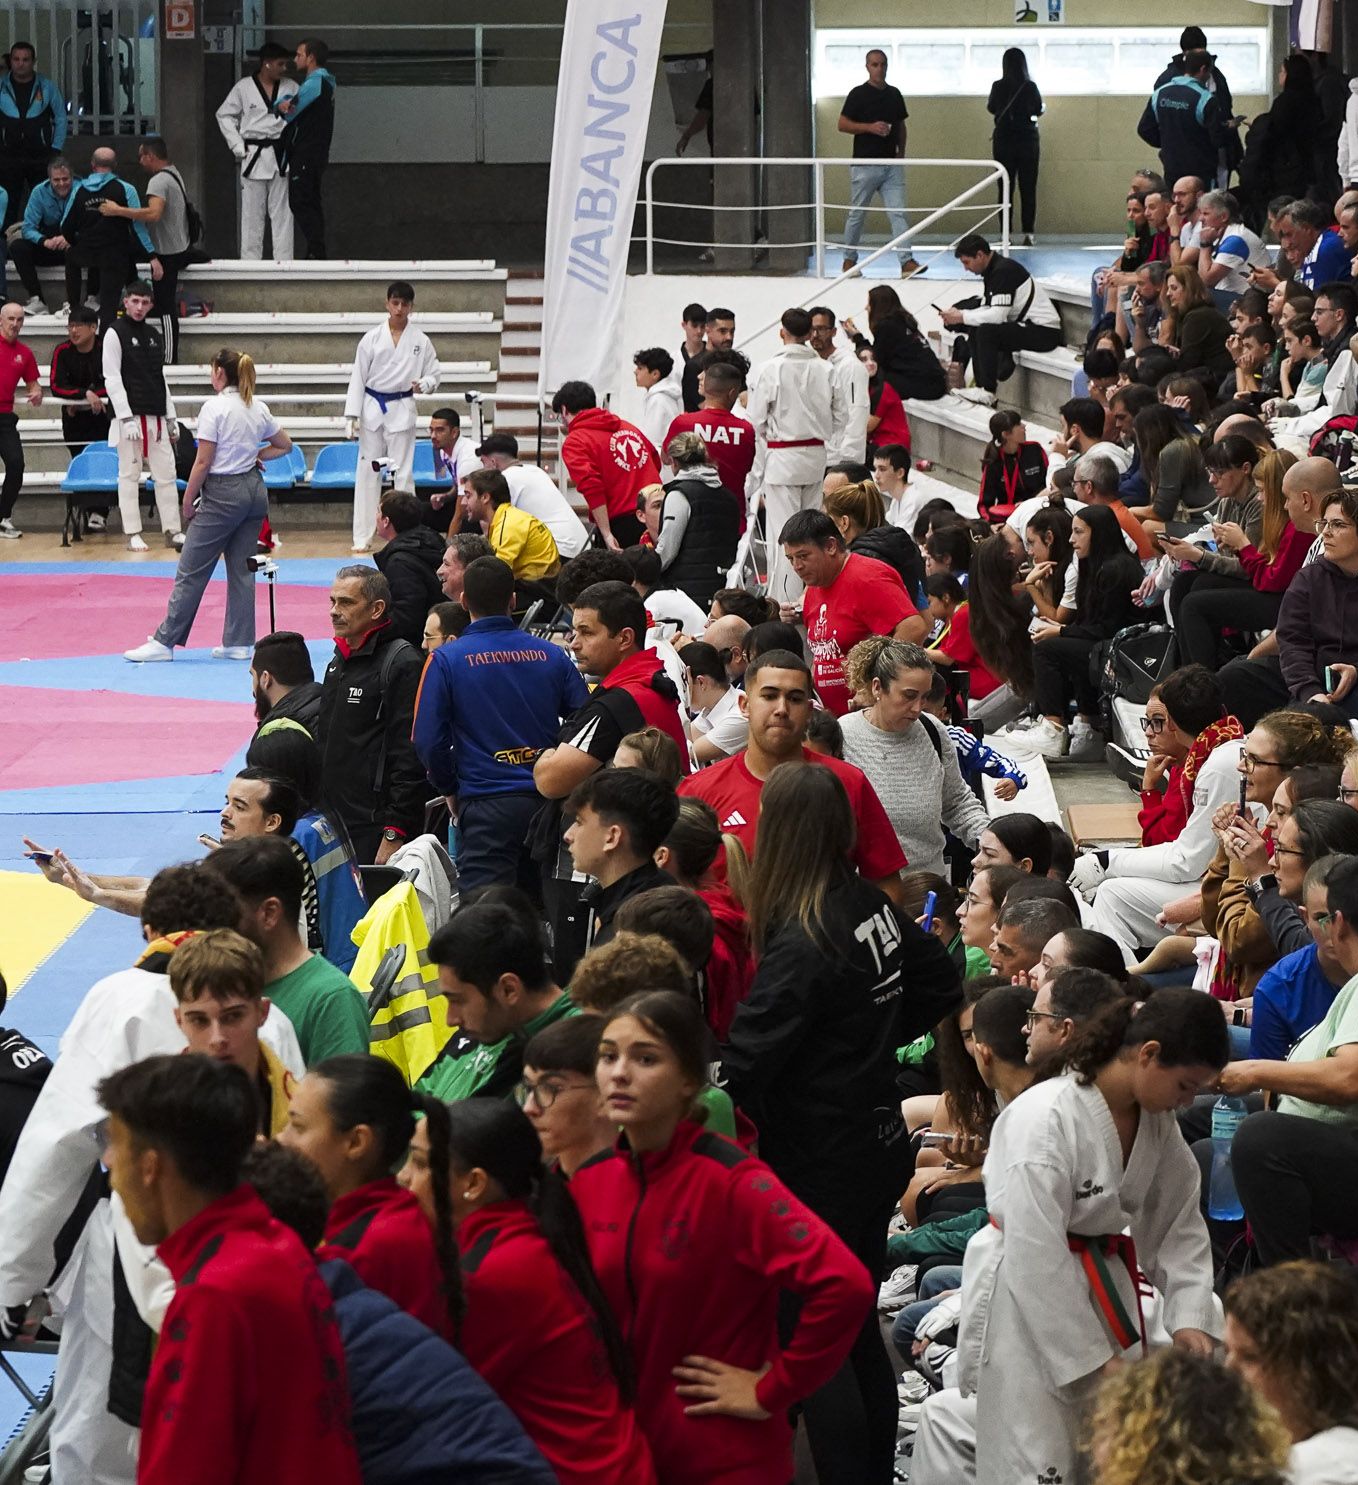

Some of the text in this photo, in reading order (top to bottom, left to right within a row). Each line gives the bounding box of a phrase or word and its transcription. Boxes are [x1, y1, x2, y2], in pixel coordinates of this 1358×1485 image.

[171, 8, 190, 28] D
[694, 423, 745, 445] NAT
[465, 650, 547, 667] TAEKWONDO
